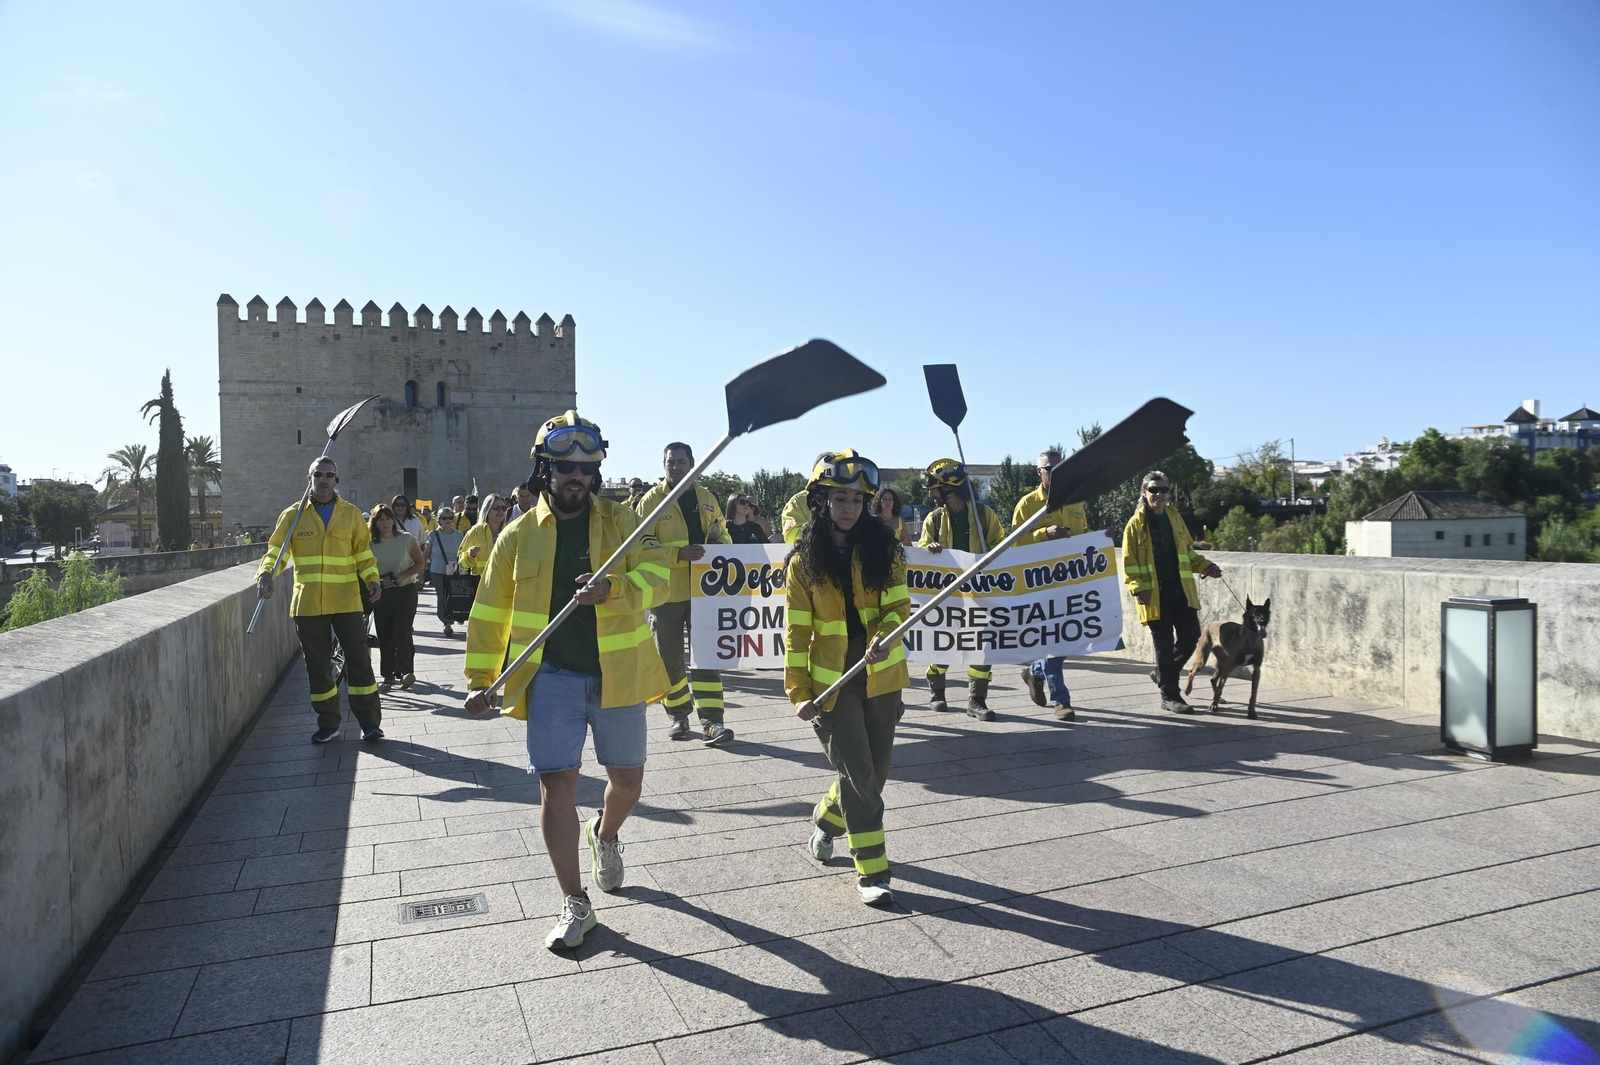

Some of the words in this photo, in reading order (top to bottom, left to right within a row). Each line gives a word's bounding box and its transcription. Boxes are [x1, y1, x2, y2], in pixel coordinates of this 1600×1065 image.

[701, 556, 786, 598] Defe
[1024, 546, 1107, 589] monte
[716, 633, 763, 660] SIN
[902, 630, 922, 651] NI
[934, 616, 1102, 652] DERECHOS
[718, 606, 784, 631] BOM
